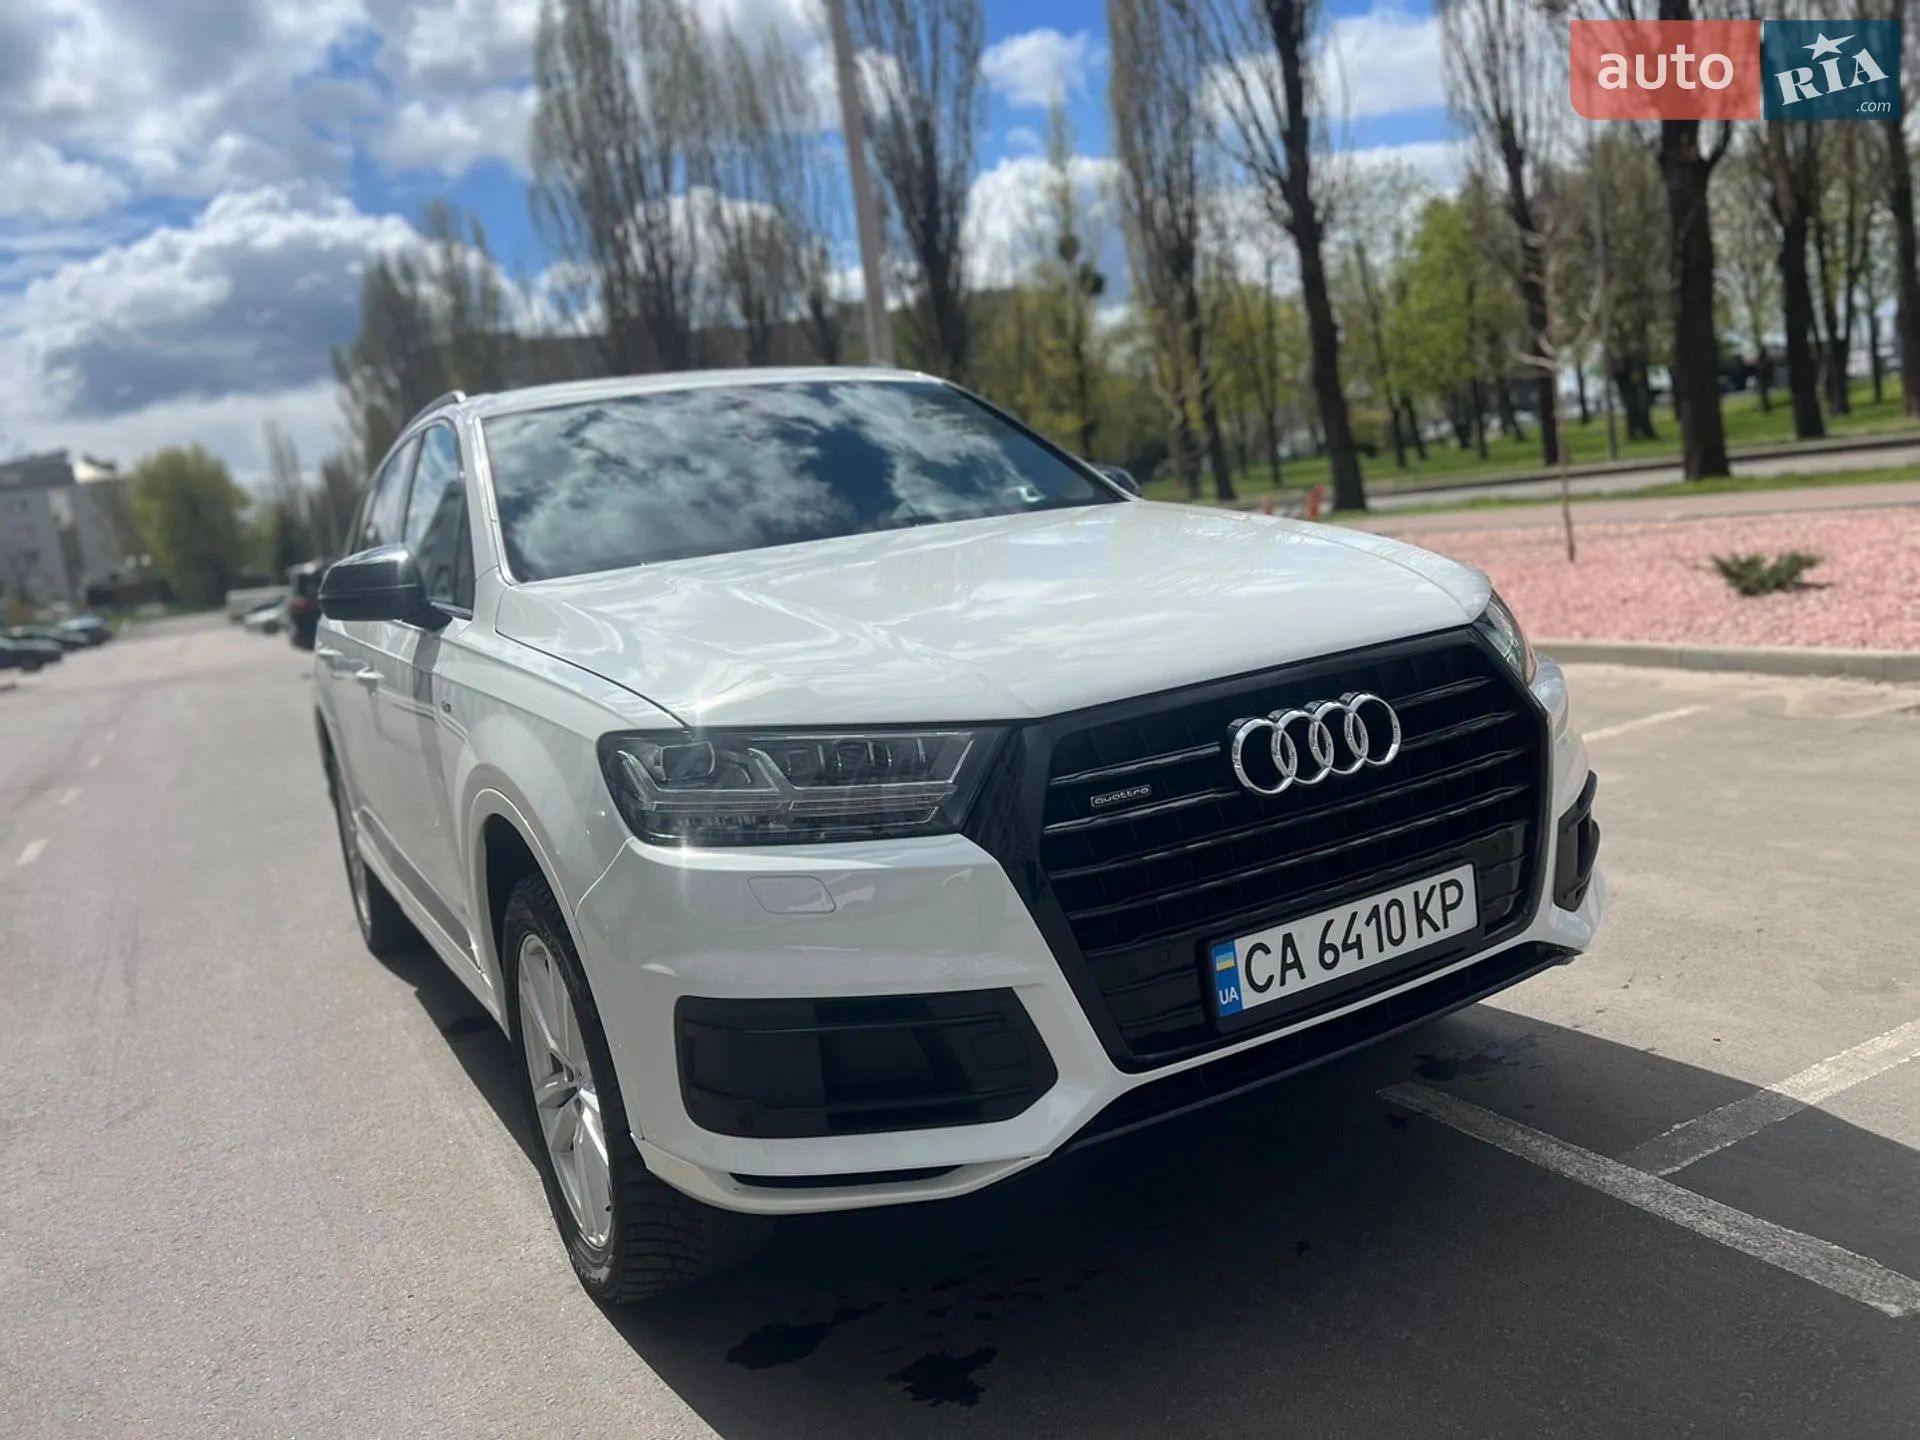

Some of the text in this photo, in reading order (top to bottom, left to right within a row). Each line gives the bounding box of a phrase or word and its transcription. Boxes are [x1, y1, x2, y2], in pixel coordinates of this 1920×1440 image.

[1094, 787, 1149, 806] quattro
[1245, 878, 1464, 993] CA 6410 KP
[1219, 986, 1239, 1005] UA
